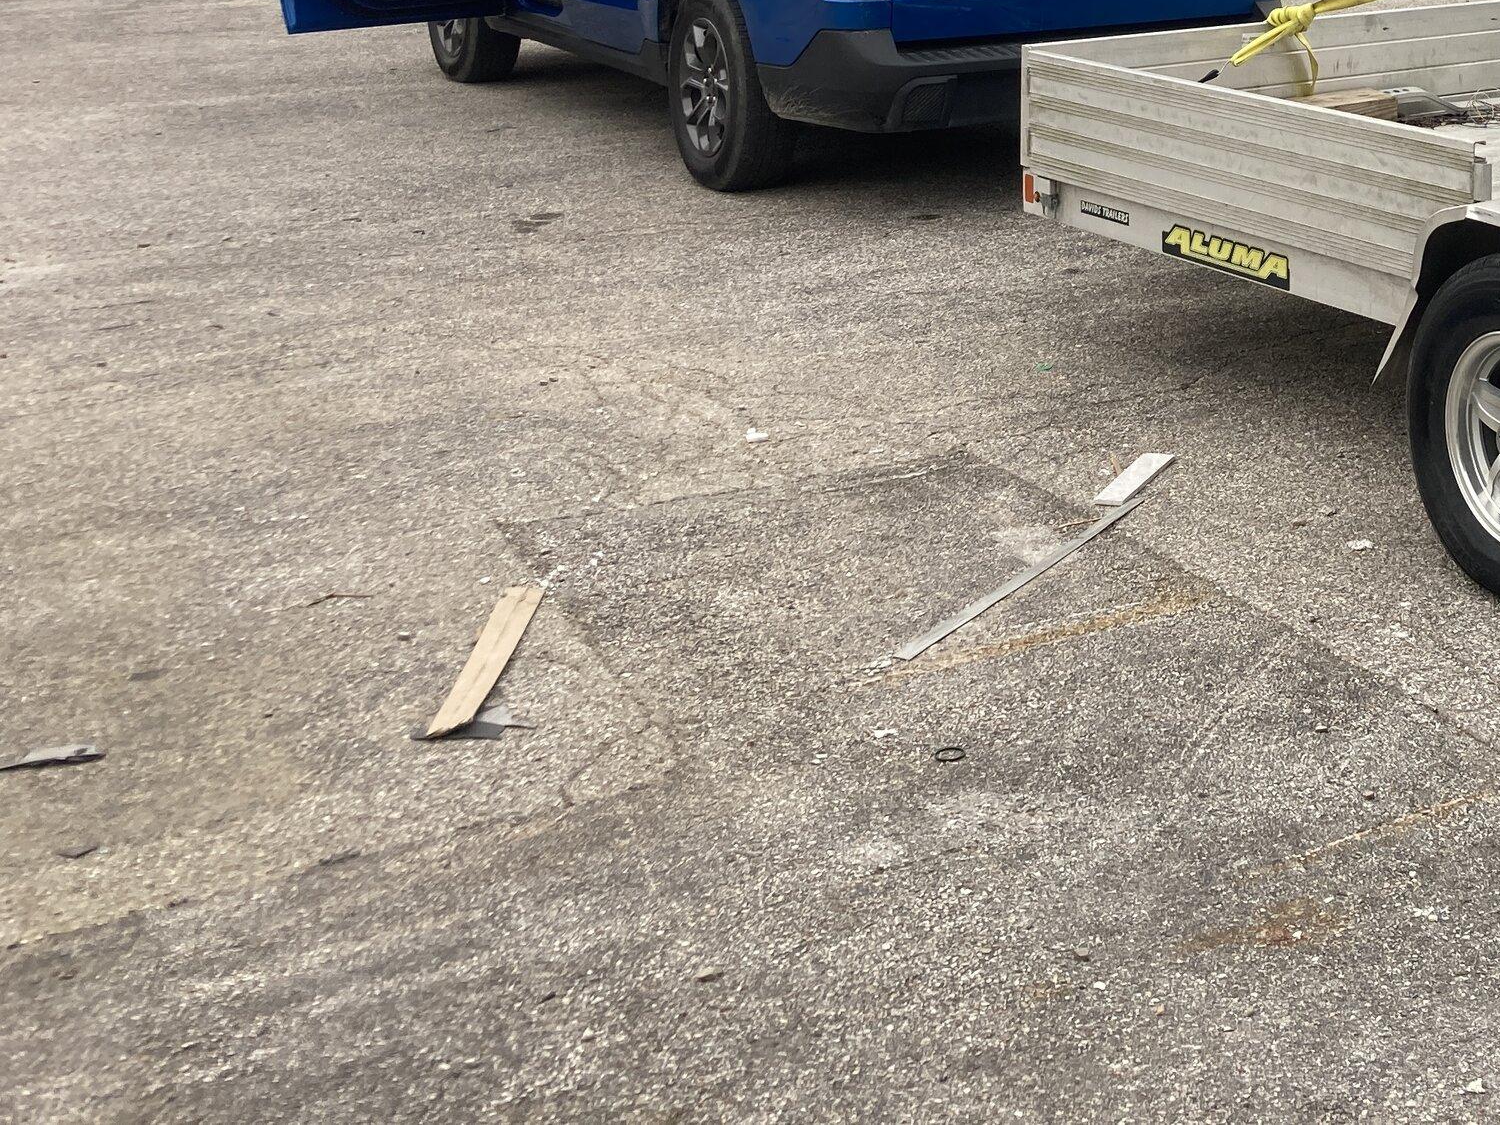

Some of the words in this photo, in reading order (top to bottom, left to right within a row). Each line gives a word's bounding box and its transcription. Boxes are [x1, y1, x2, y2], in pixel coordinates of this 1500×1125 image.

[1081, 201, 1102, 216] DAVIDS
[1102, 206, 1129, 224] TRAILERS
[1163, 225, 1289, 281] ALUMA
